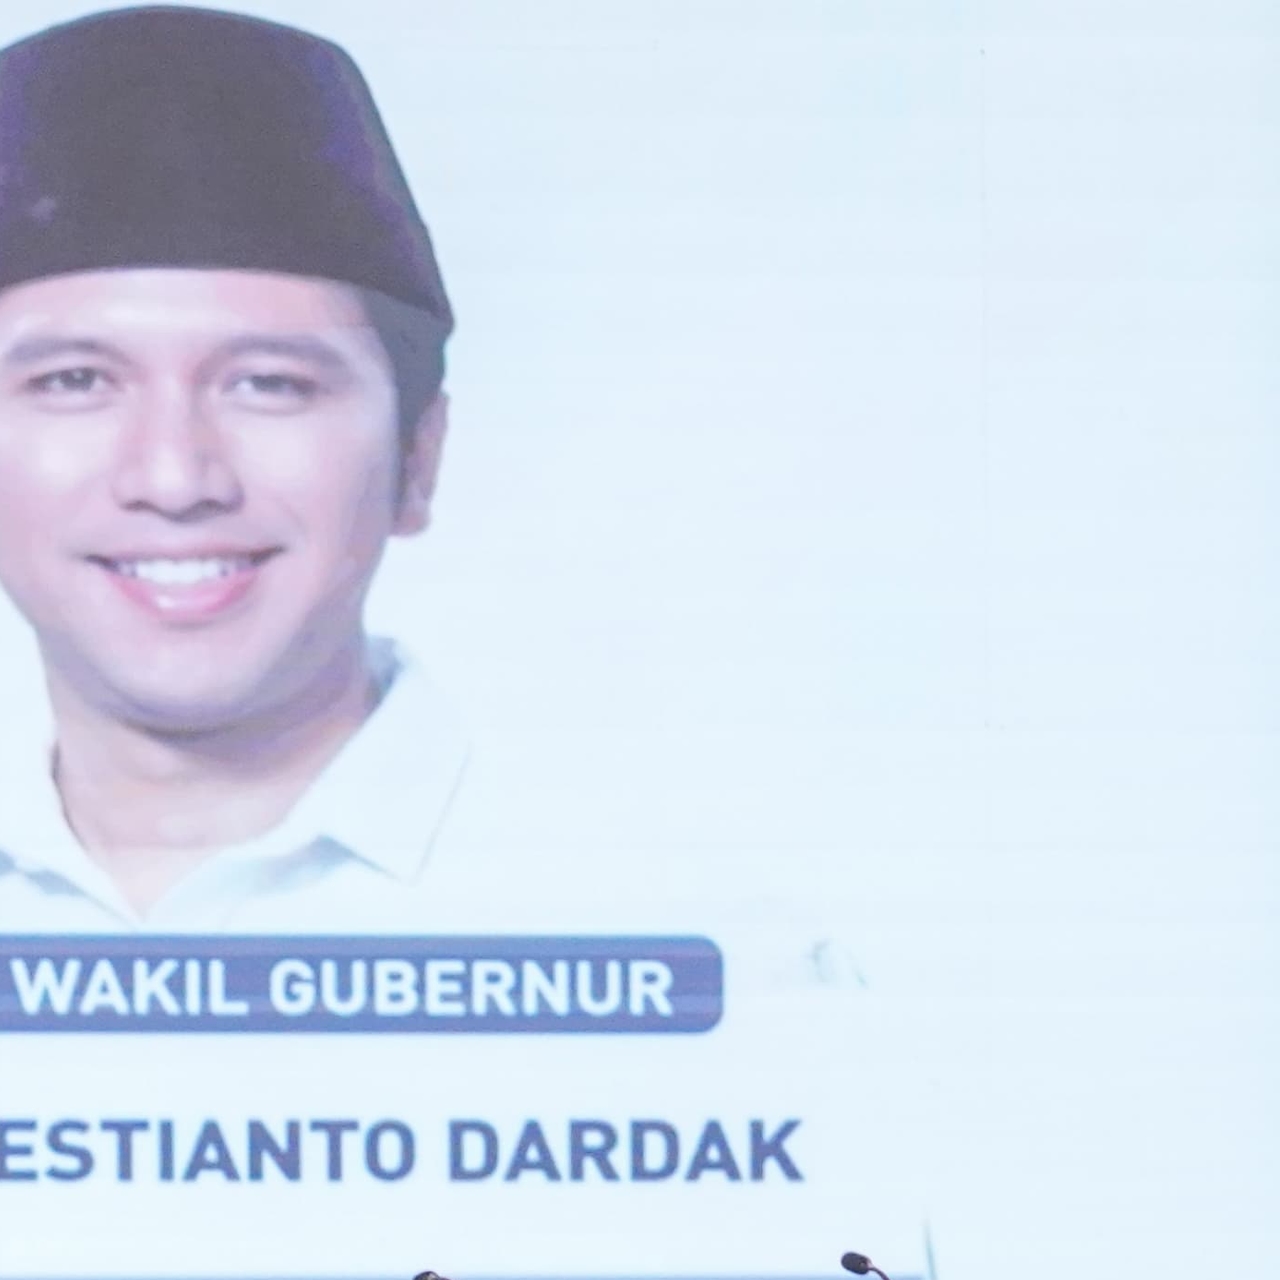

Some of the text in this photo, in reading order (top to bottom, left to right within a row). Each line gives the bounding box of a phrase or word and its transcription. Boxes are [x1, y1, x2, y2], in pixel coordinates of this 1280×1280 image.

[10, 958, 249, 1017] WAKIL
[268, 958, 675, 1017] GUBERNUR
[448, 1118, 805, 1183] DARDAK
